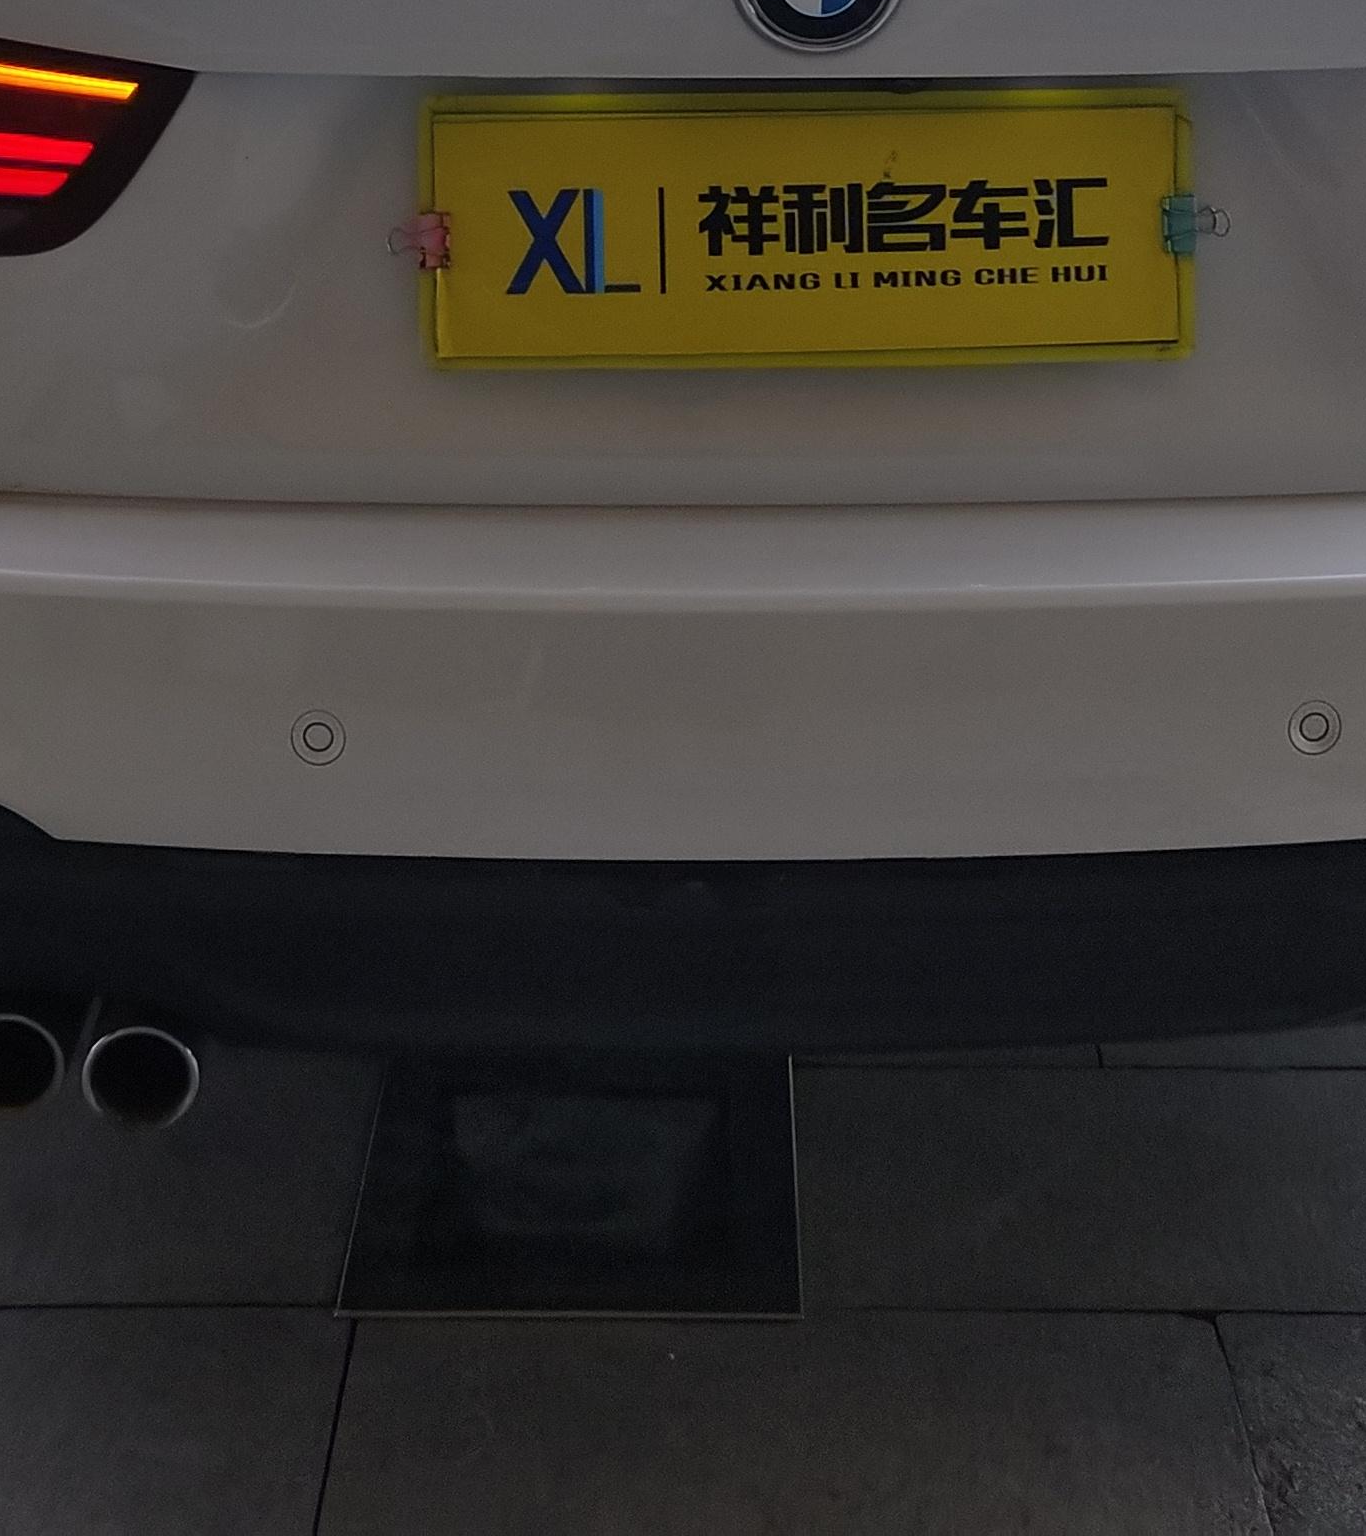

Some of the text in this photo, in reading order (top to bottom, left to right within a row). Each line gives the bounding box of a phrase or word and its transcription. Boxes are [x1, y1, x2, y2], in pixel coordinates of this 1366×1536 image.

[506, 188, 641, 295] XL
[698, 177, 1110, 257] 祥利名车汇
[705, 264, 1109, 292] XIANG LI MING CHE HUI
